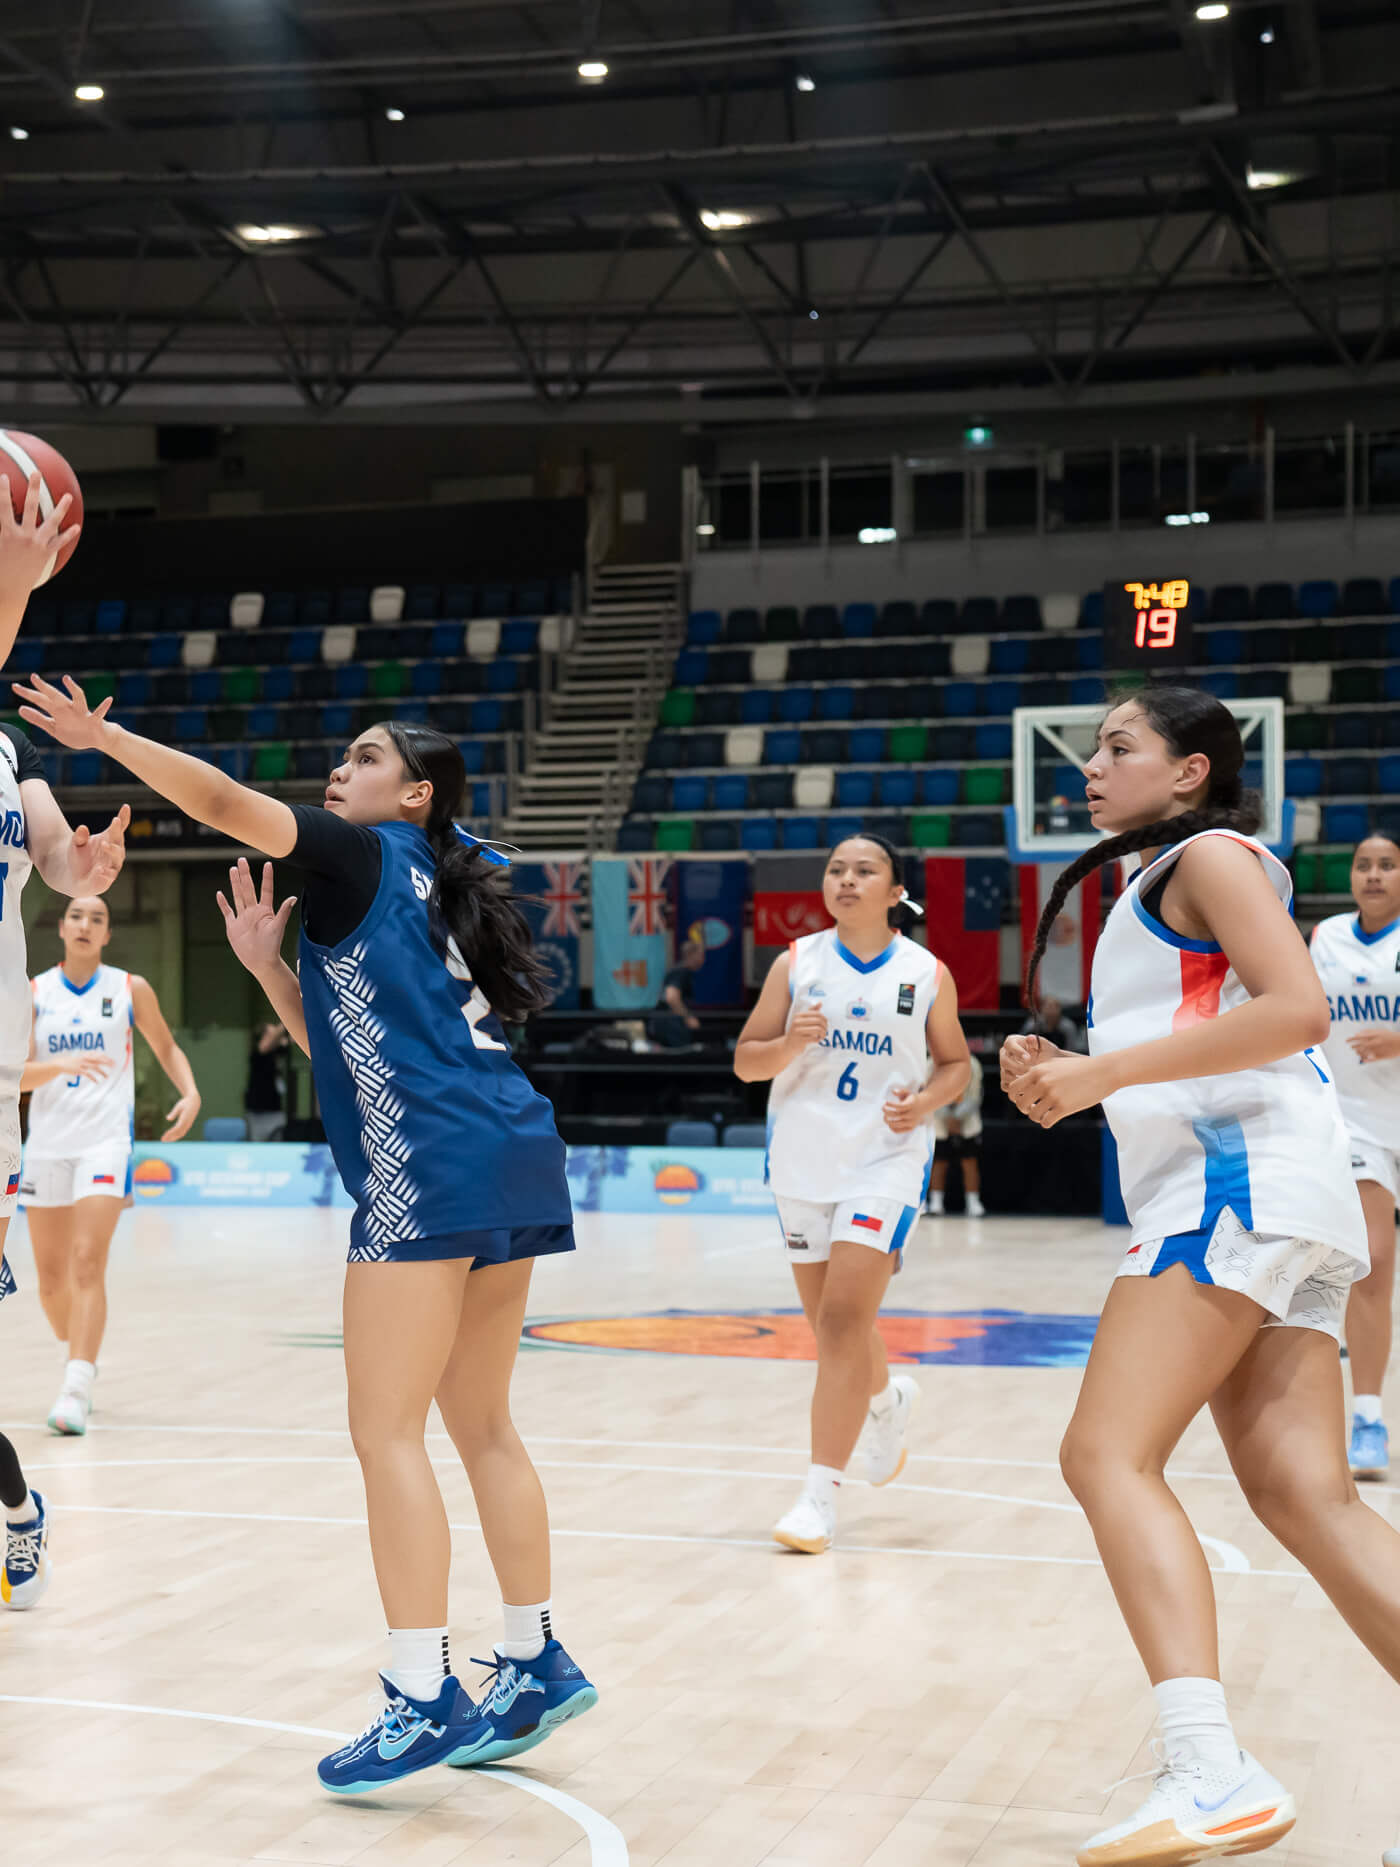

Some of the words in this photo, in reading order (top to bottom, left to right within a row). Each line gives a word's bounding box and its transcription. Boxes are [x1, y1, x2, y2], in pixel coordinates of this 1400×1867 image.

[1124, 580, 1189, 609] 7:48
[1135, 608, 1178, 648] 19
[48, 1031, 105, 1054] SAMOA
[836, 1061, 859, 1102] 6
